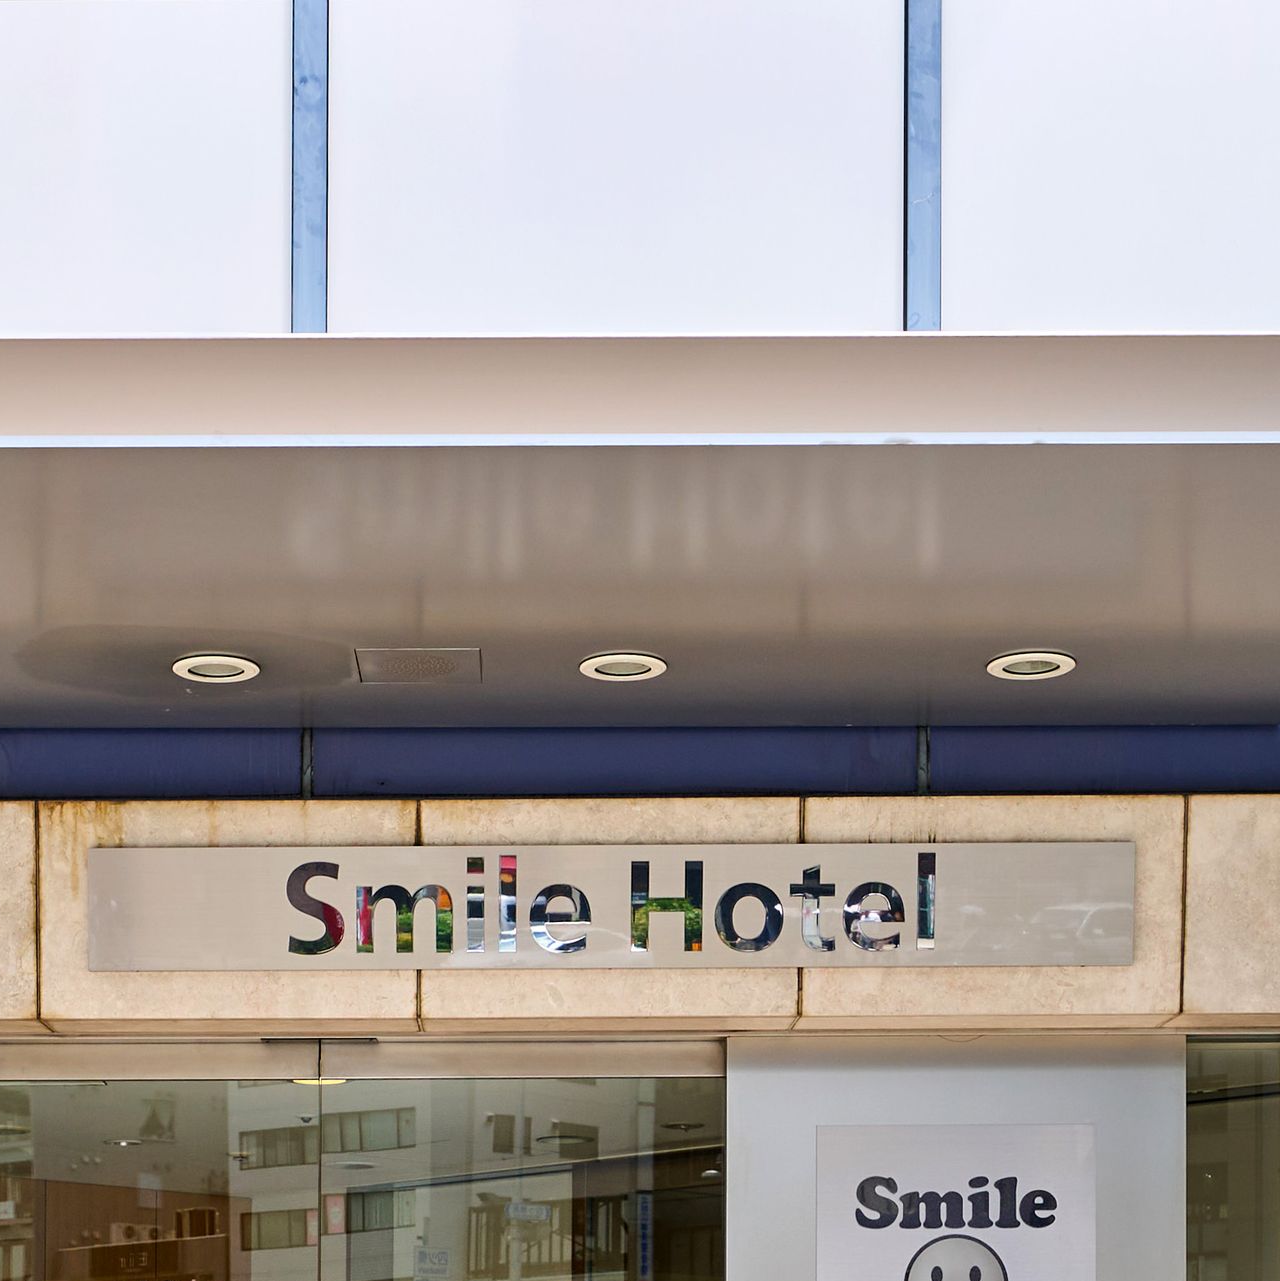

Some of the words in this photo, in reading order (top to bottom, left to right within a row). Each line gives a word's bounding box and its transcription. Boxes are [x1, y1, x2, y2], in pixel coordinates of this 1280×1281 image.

[286, 854, 592, 956] Smile
[629, 851, 937, 954] Hotel
[855, 1176, 1058, 1229] Smile
